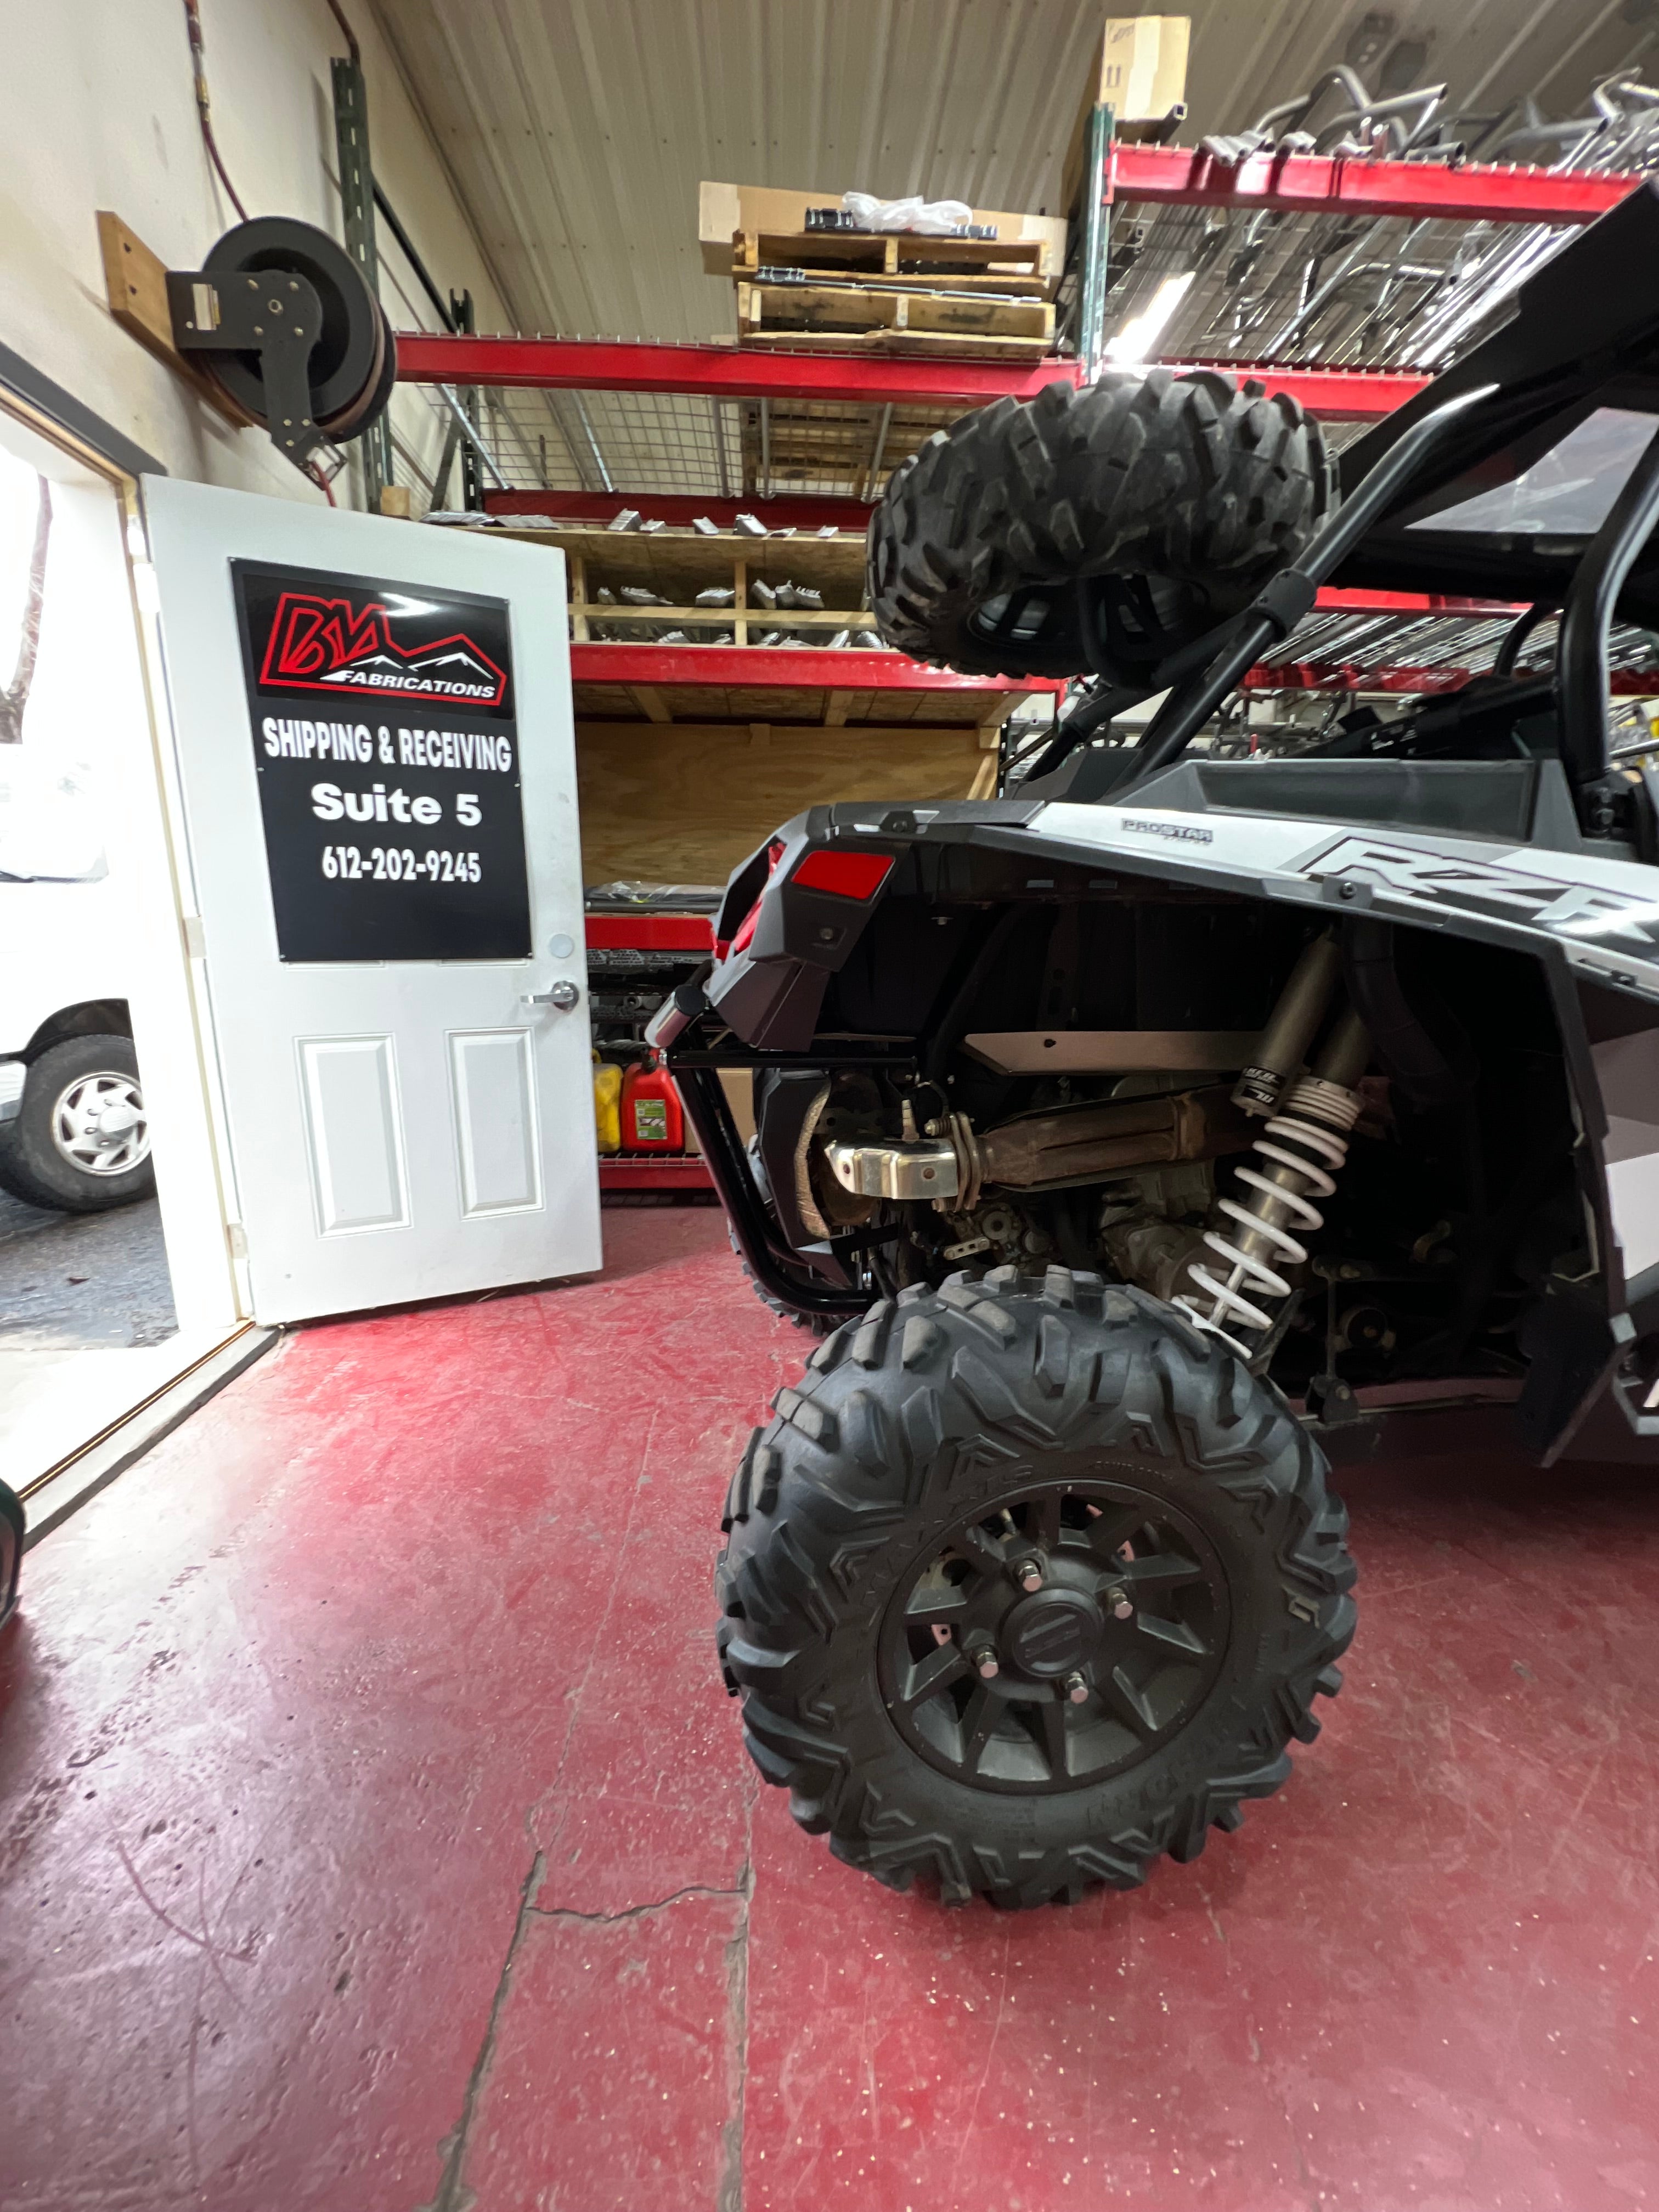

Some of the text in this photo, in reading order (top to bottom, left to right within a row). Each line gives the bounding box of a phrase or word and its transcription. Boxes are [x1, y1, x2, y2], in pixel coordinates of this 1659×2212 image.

[320, 669, 495, 698] FABRICATIONS
[262, 717, 512, 772] SHIPPING & RECEIVING
[311, 783, 483, 826] Suite 5
[1122, 818, 1214, 842] PROSTAR
[321, 845, 482, 883] 612-202-9245
[1297, 836, 1657, 944] RZR
